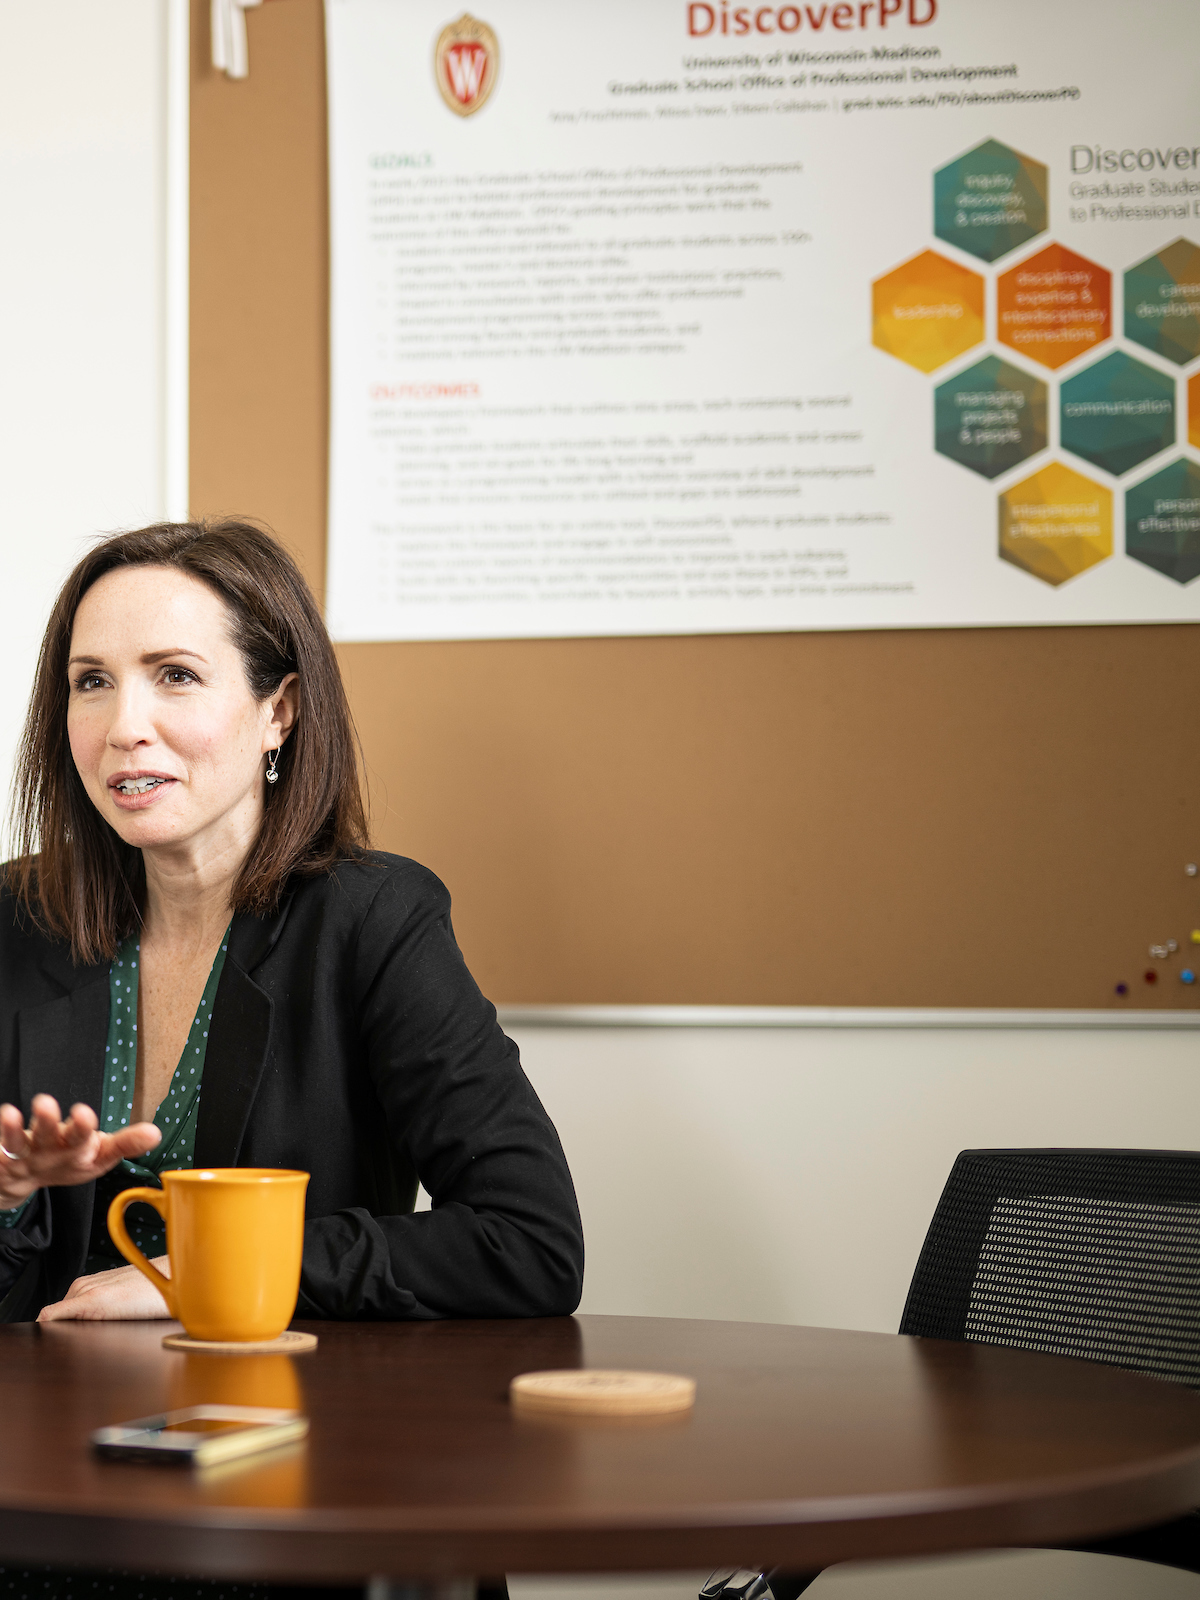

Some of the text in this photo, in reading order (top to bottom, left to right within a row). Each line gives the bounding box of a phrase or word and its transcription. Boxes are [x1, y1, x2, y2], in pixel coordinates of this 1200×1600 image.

[686, 0, 937, 37] DiscoverPD
[683, 53, 760, 71] University
[767, 50, 784, 66] of
[448, 46, 486, 99] W
[608, 63, 1019, 96] Graduate School Office of Professional Development
[1070, 144, 1200, 174] Discover
[1070, 177, 1200, 200] Graduate Stude
[970, 208, 1027, 226] creation
[1070, 205, 1086, 222] to
[1090, 201, 1190, 221] Professional
[1016, 269, 1092, 289] disciplinary
[1016, 287, 1093, 307] expertise &
[892, 302, 964, 321] leadership
[1002, 305, 1106, 326] interdisciplinary
[1012, 325, 1097, 344] connections
[955, 389, 1025, 409] managing
[1064, 397, 1172, 418] communication
[961, 407, 1019, 427] projects
[975, 427, 1022, 446] people
[1011, 500, 1100, 519] interpersonal
[1010, 519, 1101, 539] effectiveness
